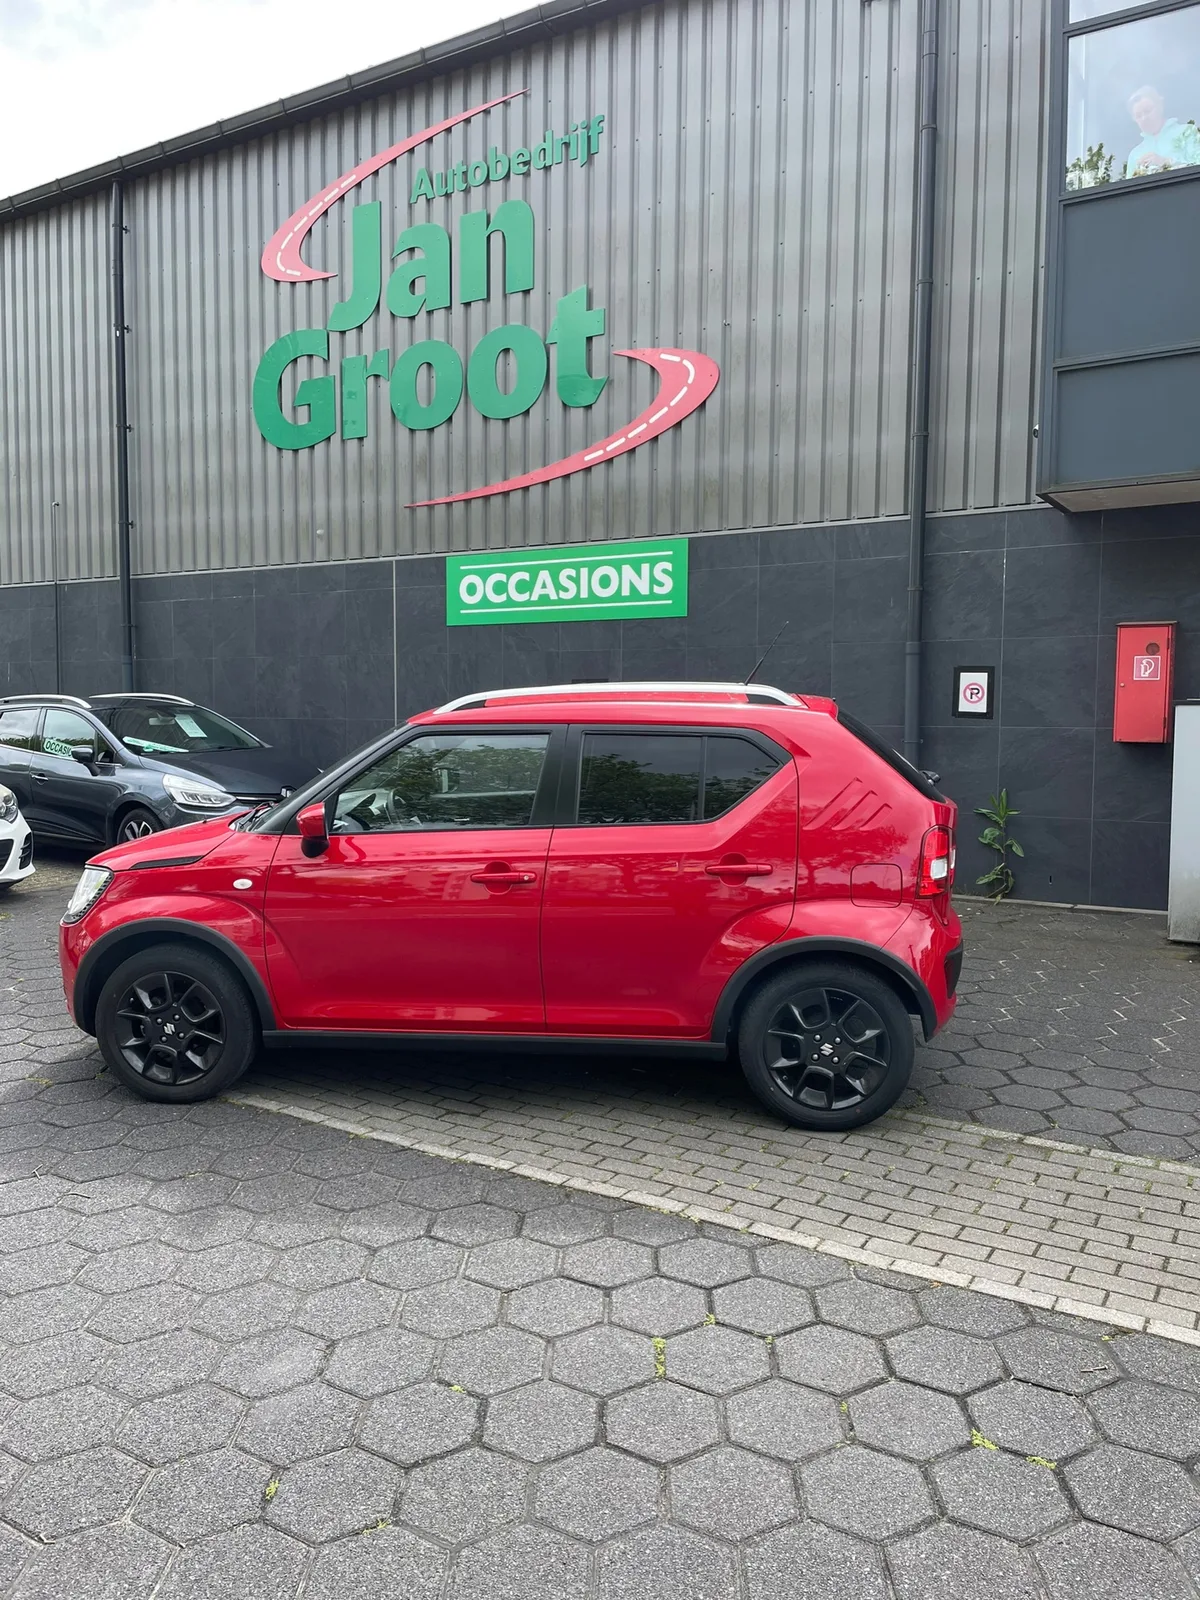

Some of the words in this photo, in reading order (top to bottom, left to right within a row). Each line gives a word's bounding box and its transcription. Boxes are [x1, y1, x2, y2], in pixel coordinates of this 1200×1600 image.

[411, 116, 605, 204] Autobedrijf
[327, 200, 534, 331] Jan
[252, 285, 608, 450] Groot
[459, 561, 674, 604] OCCASIONS
